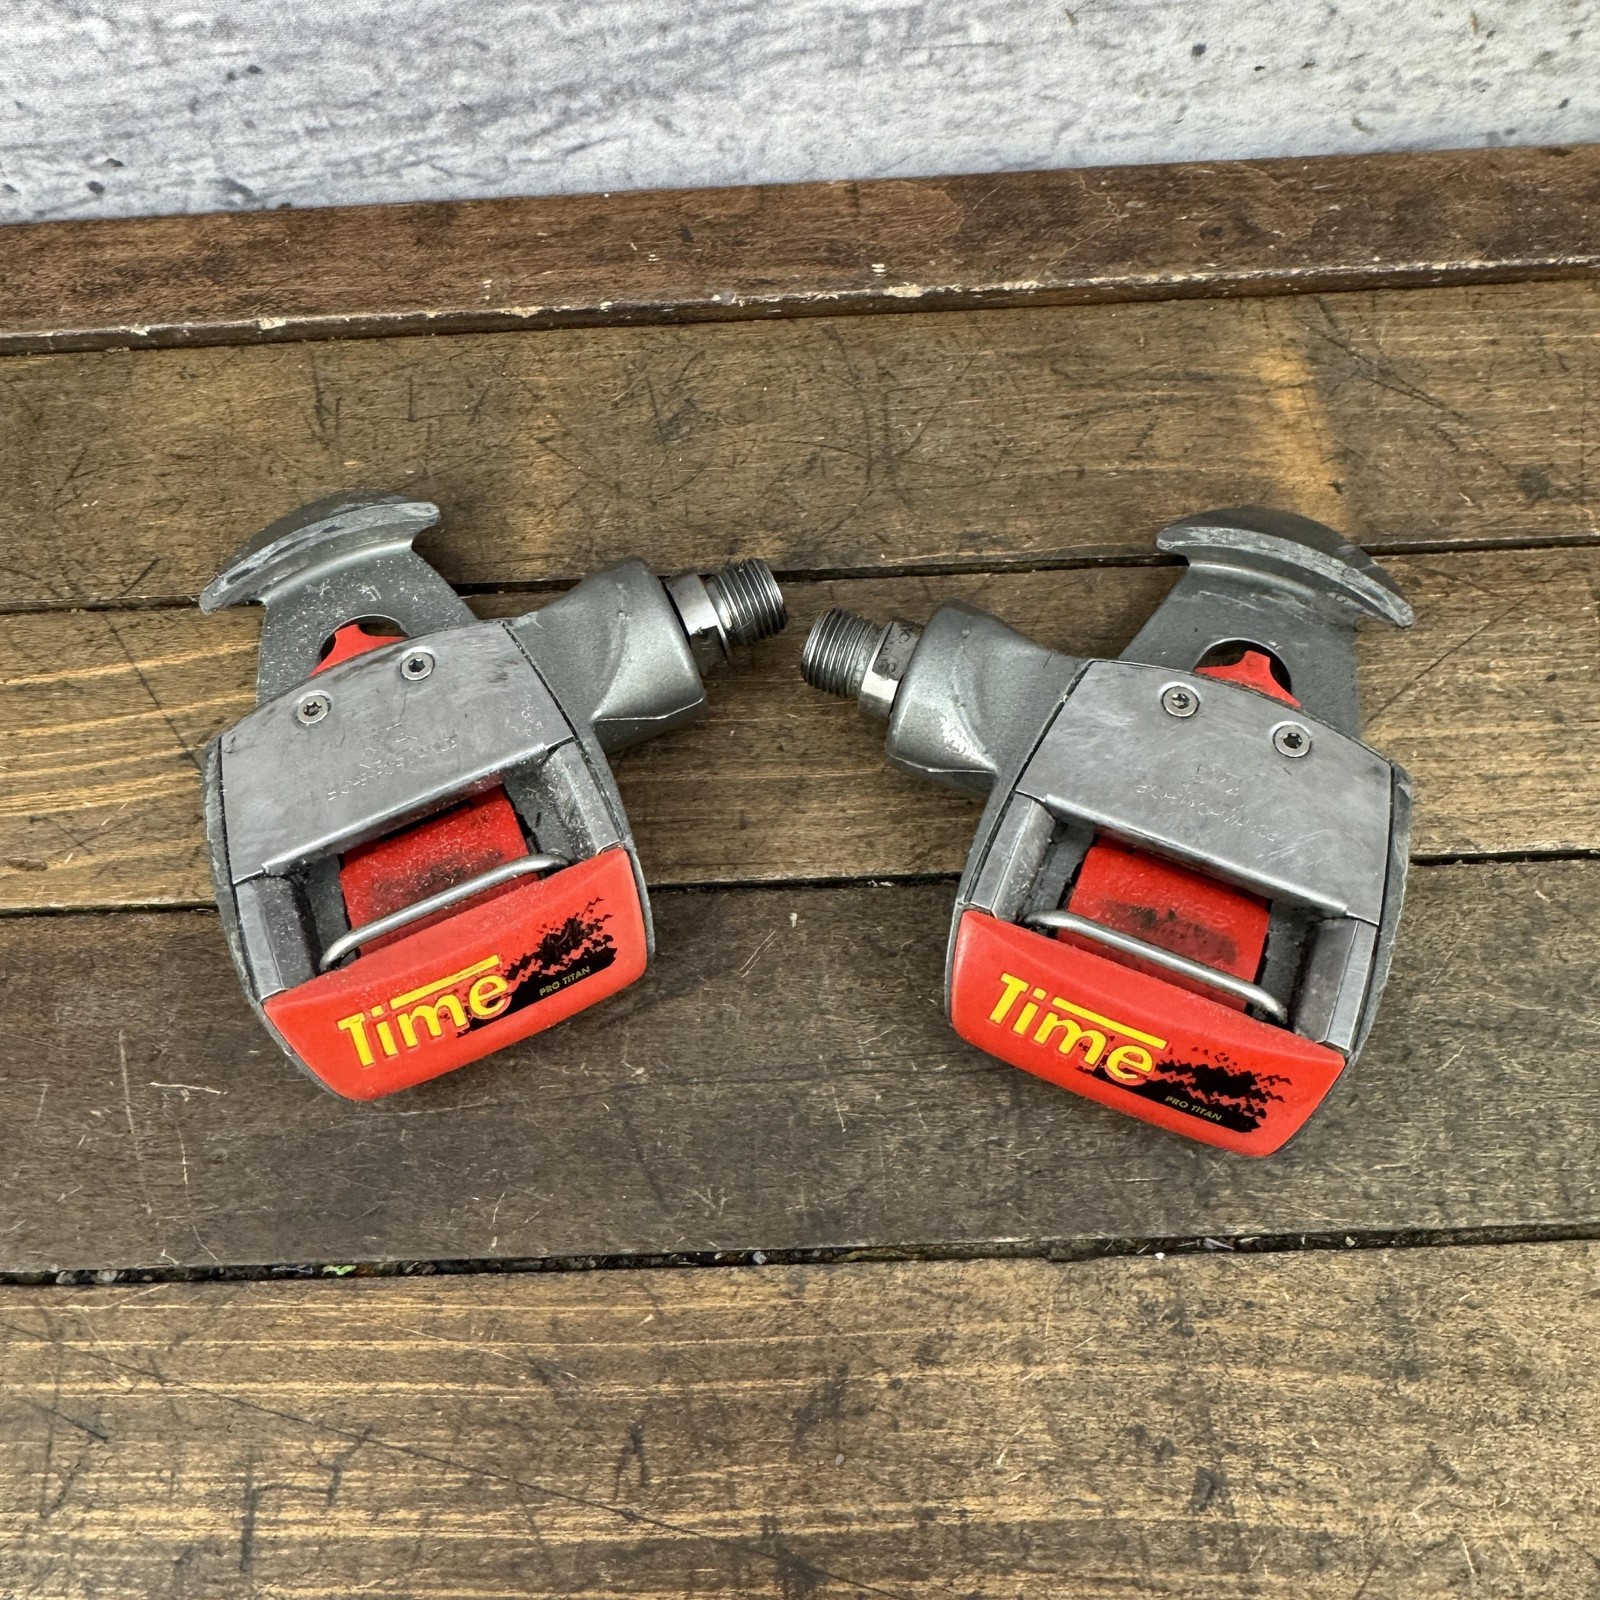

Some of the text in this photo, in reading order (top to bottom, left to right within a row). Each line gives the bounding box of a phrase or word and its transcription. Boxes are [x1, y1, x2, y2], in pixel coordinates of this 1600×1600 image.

[337, 956, 509, 1067] Time
[539, 965, 591, 996] PRO TITAN
[989, 972, 1155, 1080] Time
[1165, 1095, 1222, 1121] PRO TITAN
